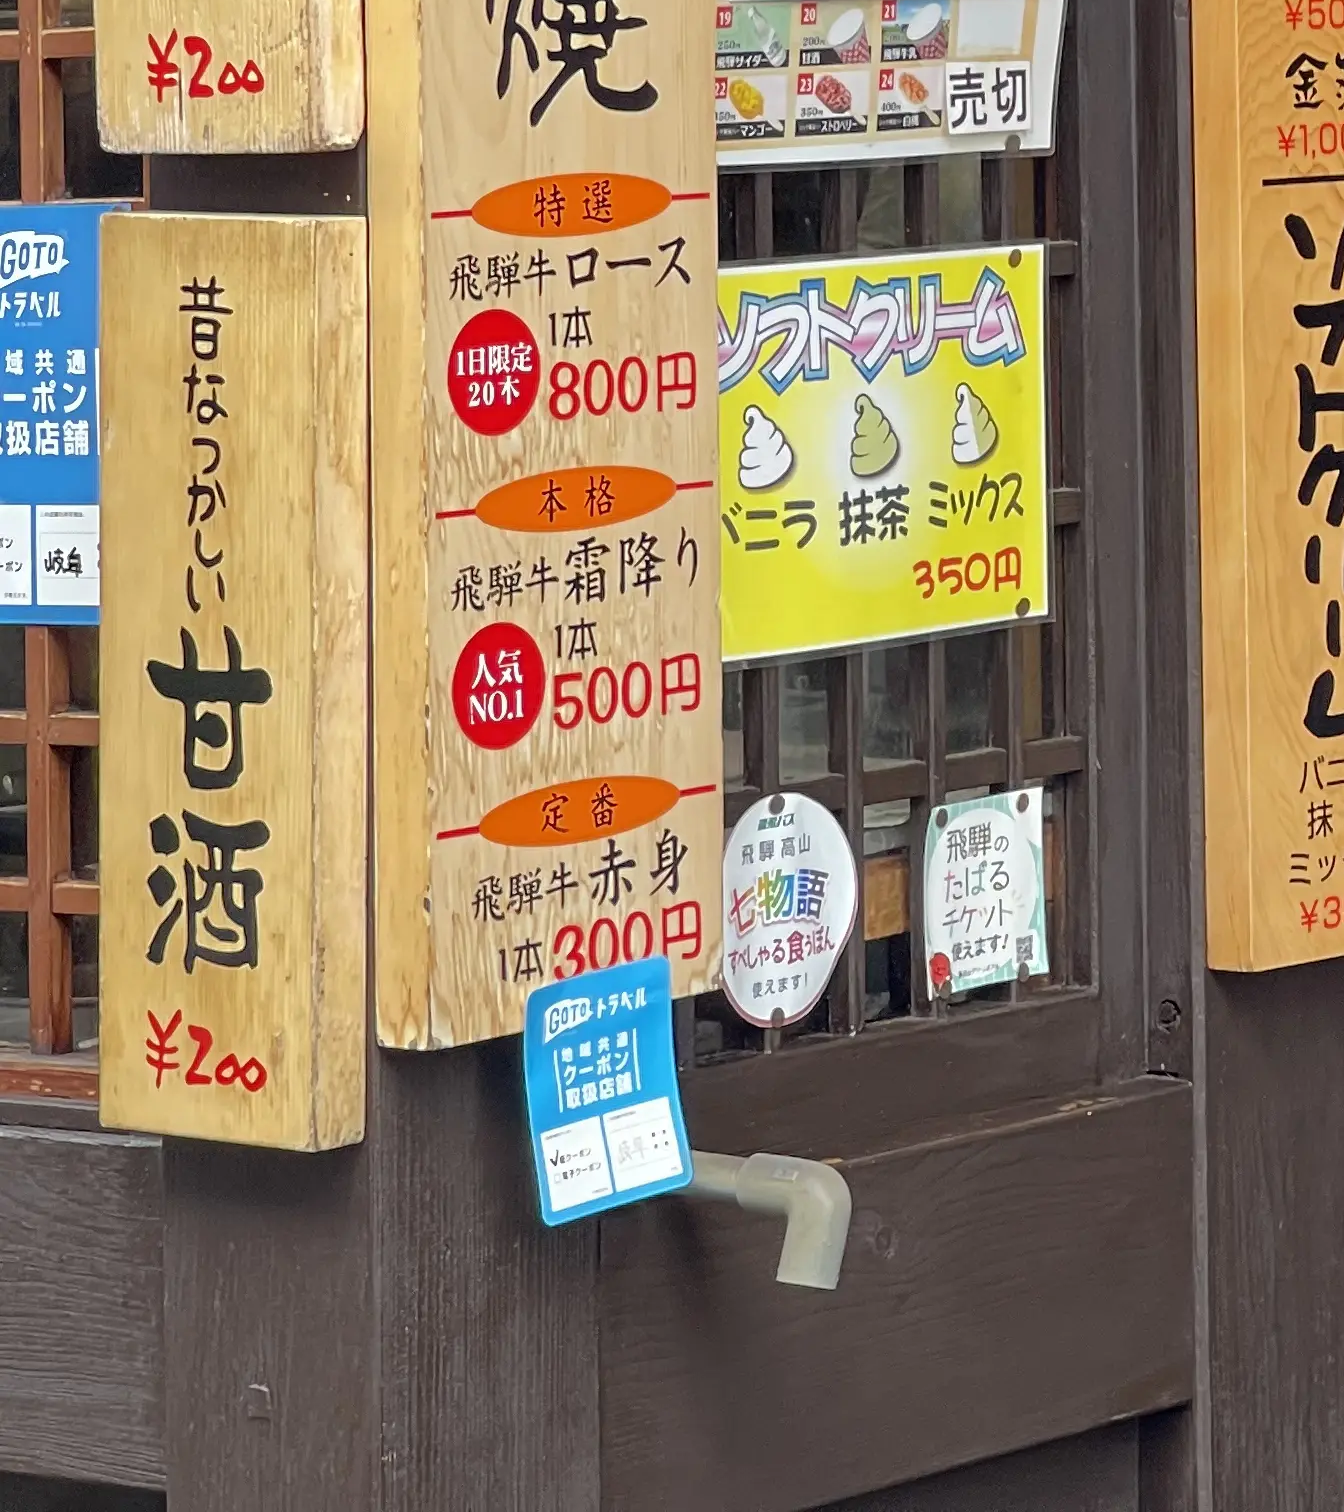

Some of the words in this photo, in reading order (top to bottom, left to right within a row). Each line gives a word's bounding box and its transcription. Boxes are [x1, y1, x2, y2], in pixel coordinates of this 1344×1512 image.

[719, 11, 732, 25] 19
[803, 7, 816, 22] 20
[883, 4, 896, 19] 21
[146, 27, 265, 104] ¥200
[799, 77, 813, 92] 23
[881, 73, 893, 88] 24
[948, 66, 1029, 129] 売切
[740, 124, 773, 137] マンゴー
[820, 120, 857, 134] ストロベリー
[532, 179, 615, 228] 特選
[0, 238, 59, 280] GOTO
[448, 236, 692, 302] 飛騨牛ロース
[549, 305, 594, 348] 1本
[717, 265, 1027, 396] ソフトクリーム
[456, 341, 533, 376] 1日限定
[548, 350, 697, 421] 800円
[538, 474, 616, 523] 本格
[838, 483, 911, 548] 抹茶
[927, 473, 1025, 528] ミックス
[451, 525, 699, 613] 飛騨牛霜降り
[912, 546, 1023, 600] 350円
[554, 617, 599, 660] 1本
[472, 649, 524, 688] 人気
[468, 690, 524, 725] NO.1
[552, 652, 701, 731] 500円
[540, 782, 619, 834] 定番
[741, 832, 811, 866] 飛騨高山
[946, 821, 1010, 864] 飛騨の
[471, 827, 690, 923] 飛騨牛赤身
[728, 867, 830, 937] 七物語
[942, 898, 1013, 938] チケット
[498, 938, 544, 983] 1本
[552, 899, 702, 981] 300円
[549, 1002, 588, 1034] GOTO
[596, 987, 647, 1020] トラベル
[146, 1008, 268, 1092] ¥200
[563, 1051, 630, 1086] クーポン
[565, 1071, 633, 1110] 取扱店舗
